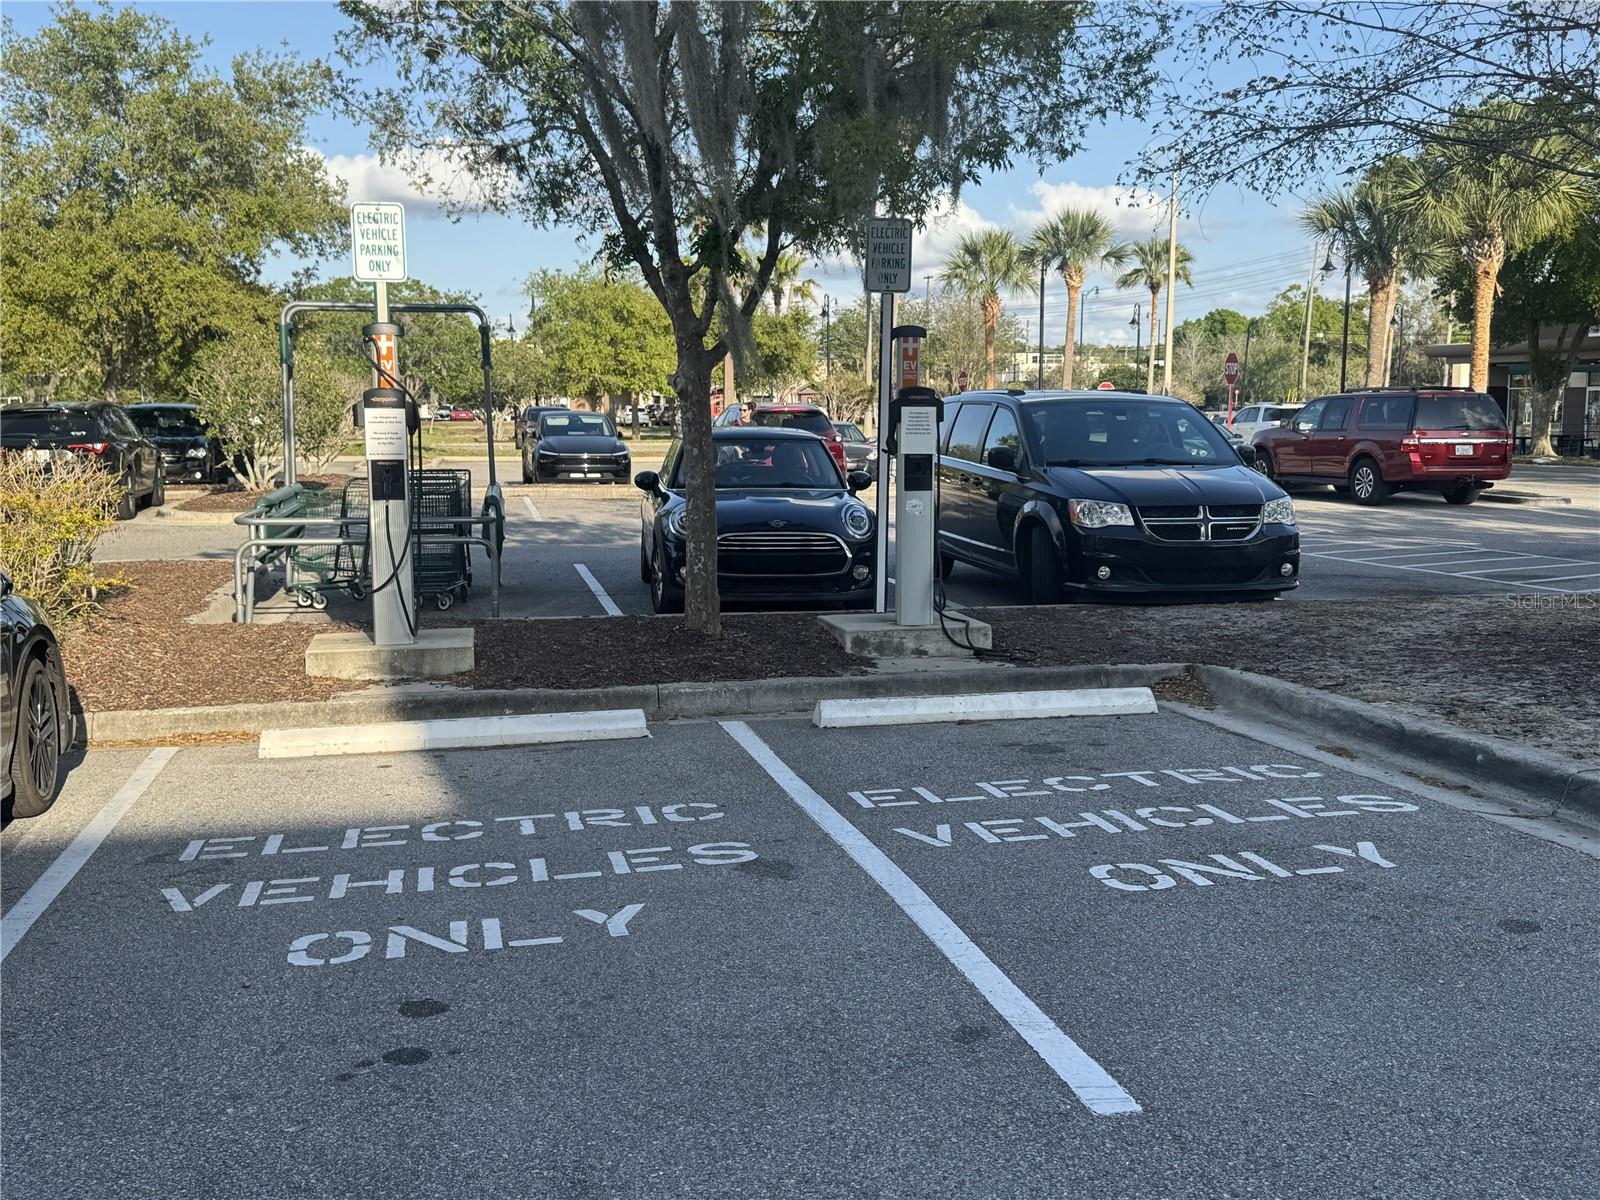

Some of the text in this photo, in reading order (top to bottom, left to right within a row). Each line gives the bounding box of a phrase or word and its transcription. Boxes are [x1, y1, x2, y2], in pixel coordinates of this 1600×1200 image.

[356, 211, 399, 225] ELECTRIC
[359, 228, 398, 241] VEHICLE
[870, 226, 908, 239] ELECTRIC
[359, 243, 399, 257] PARKING
[872, 242, 905, 255] VEHICLE
[368, 259, 391, 272] ONLY
[871, 257, 906, 270] PARKING
[878, 272, 898, 284] ONLY
[903, 360, 917, 370] EV
[1225, 362, 1239, 375] STOP
[847, 763, 1324, 809] ELECTRIC
[891, 794, 1420, 847] VEHICLES
[178, 802, 725, 862] ELECTRIC
[1088, 841, 1397, 892] ONLY
[160, 841, 760, 912] VEHICLES
[286, 903, 646, 966] ONLY
